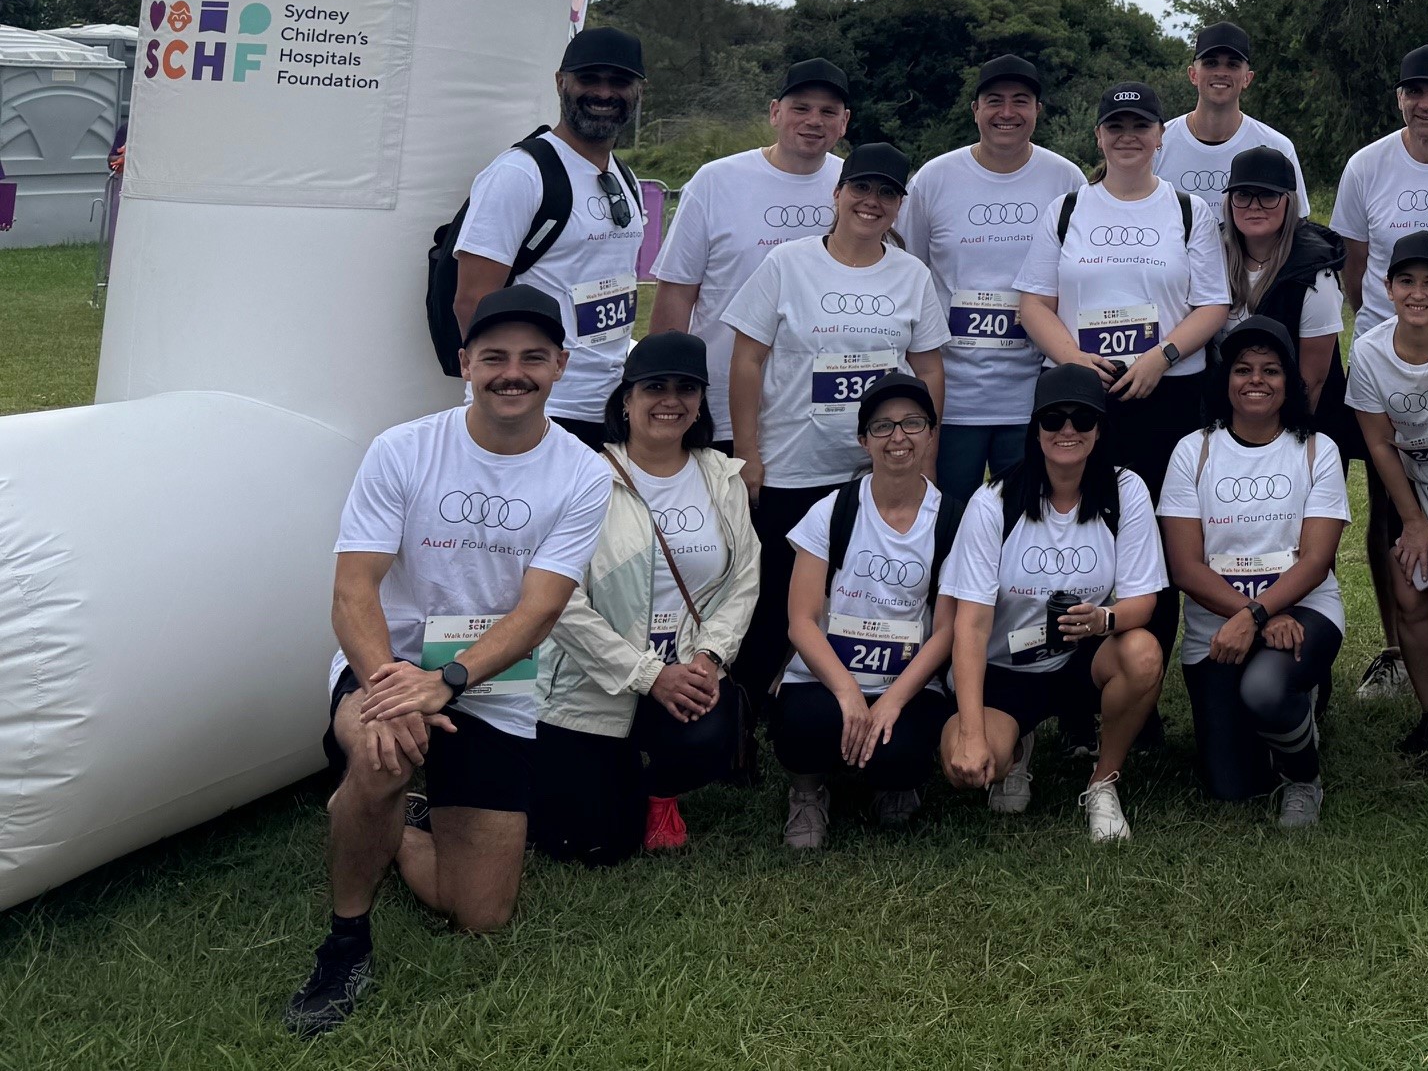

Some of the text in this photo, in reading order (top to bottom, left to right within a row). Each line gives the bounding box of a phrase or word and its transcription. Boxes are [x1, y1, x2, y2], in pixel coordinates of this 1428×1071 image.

[284, 4, 350, 24] Sydney
[280, 27, 369, 45] Children's
[143, 38, 267, 83] SCHF
[279, 48, 361, 67] Hospitals
[277, 70, 379, 90] Foundation
[1389, 221, 1411, 229] Audi
[587, 233, 607, 241] Audi
[960, 234, 1034, 244] Audi Foundati
[1079, 256, 1167, 267] Audi Foundation
[596, 300, 627, 329] 334
[812, 325, 901, 337] Audi Foundation
[967, 313, 1008, 336] 240
[1098, 330, 1138, 354] 207
[1208, 515, 1233, 524] Audi
[421, 537, 457, 549] Audi
[837, 585, 922, 607] Audi Foundation
[1008, 585, 1036, 596] Audi
[849, 645, 892, 671] 241
